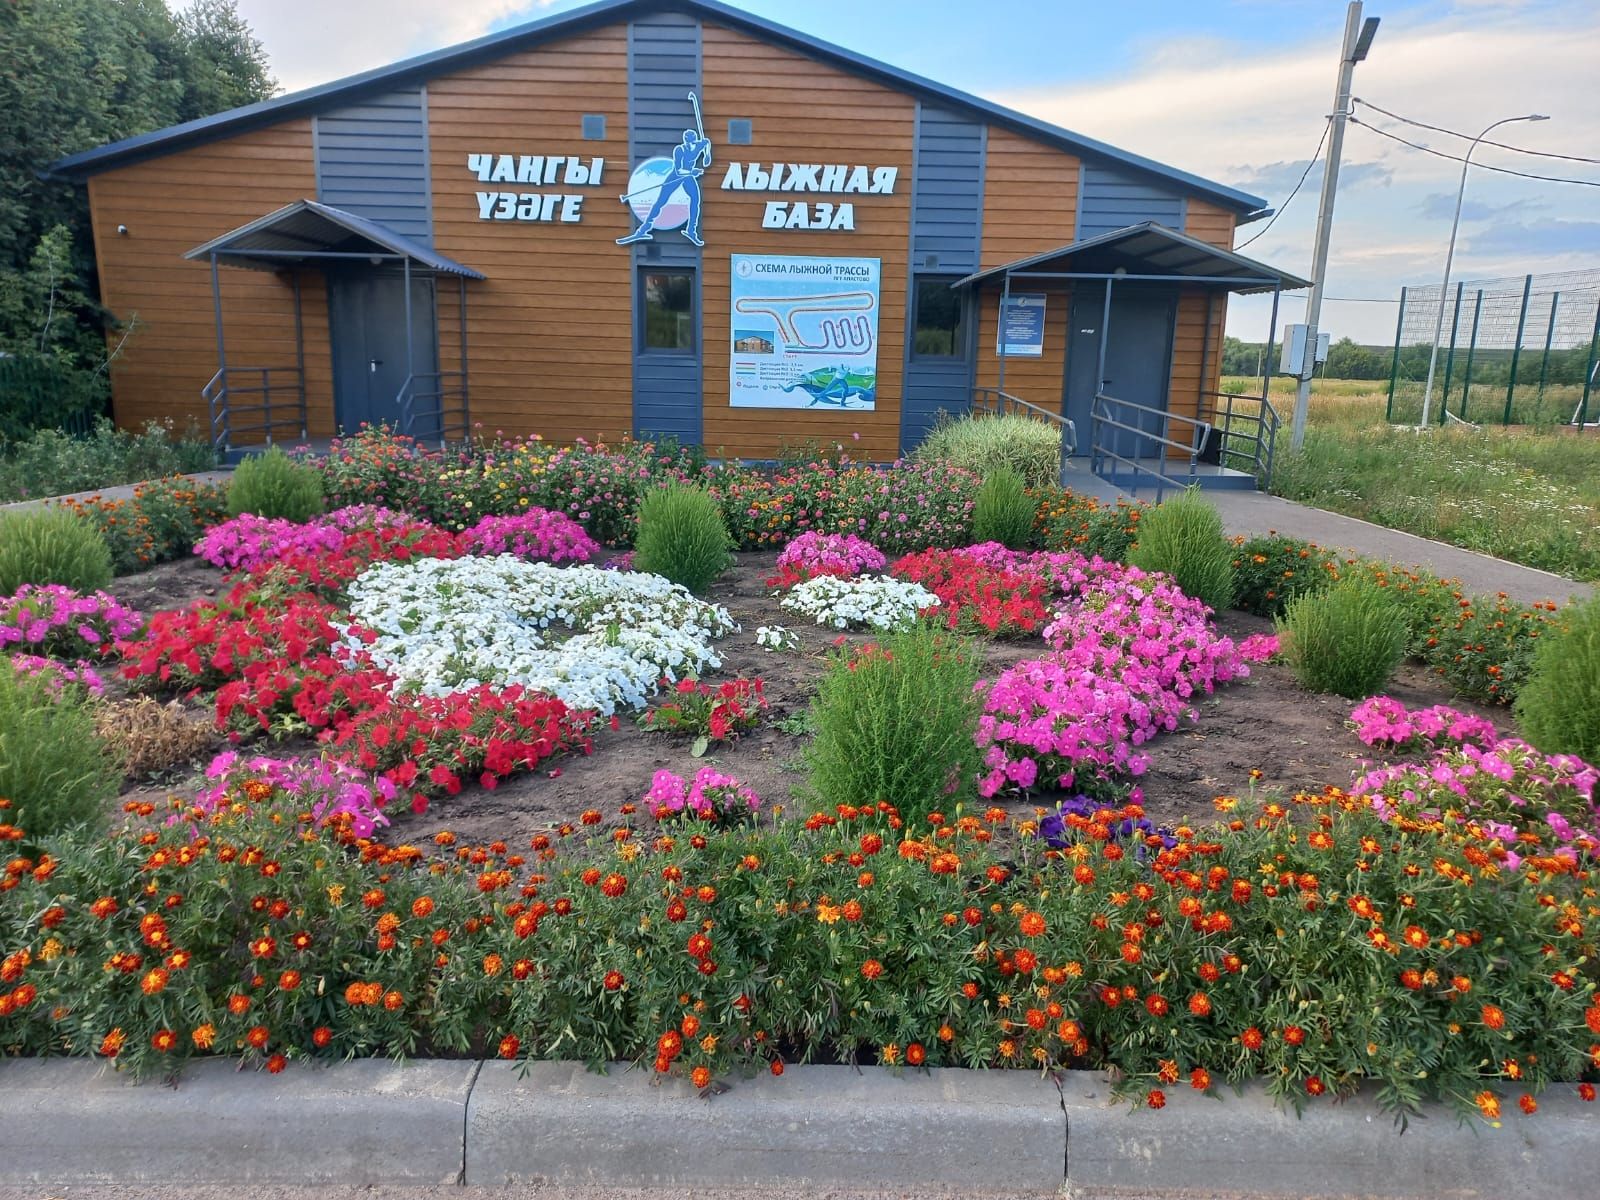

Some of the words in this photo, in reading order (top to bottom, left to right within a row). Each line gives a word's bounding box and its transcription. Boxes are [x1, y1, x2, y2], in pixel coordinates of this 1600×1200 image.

[467, 153, 604, 186] ЧАҢГЫ
[721, 162, 898, 194] ЛЫЖНАЯ
[476, 192, 583, 223] ҮЗӘГЕ
[761, 201, 856, 230] БАЗА
[755, 263, 787, 273] СХЕМА
[789, 263, 832, 275] ЛЫЖНОЙ
[834, 266, 870, 276] ТРАССЫ
